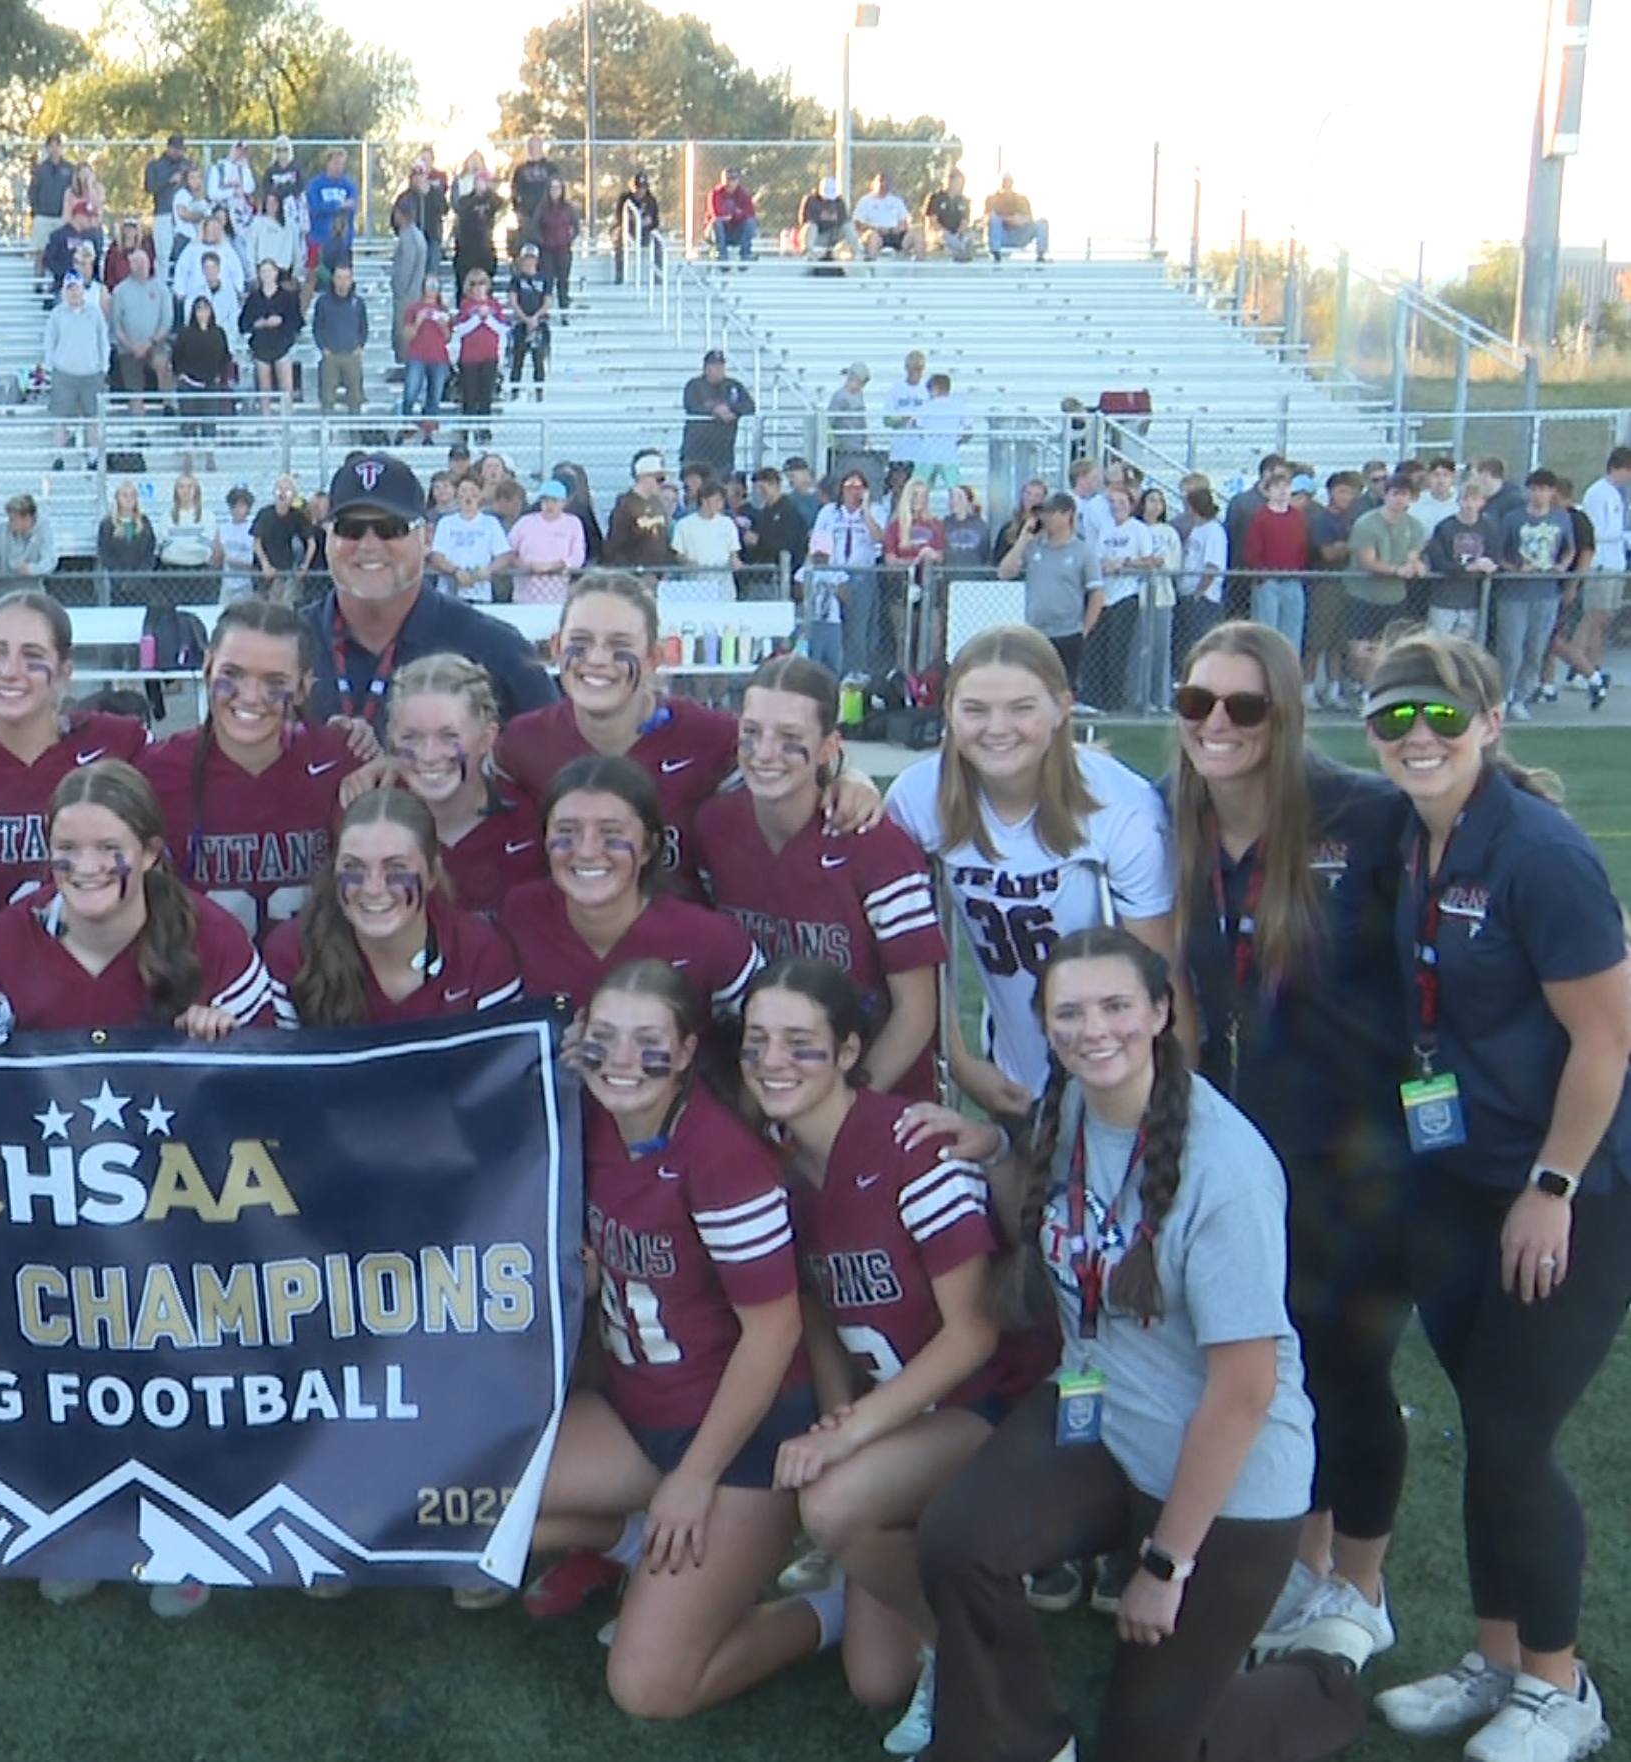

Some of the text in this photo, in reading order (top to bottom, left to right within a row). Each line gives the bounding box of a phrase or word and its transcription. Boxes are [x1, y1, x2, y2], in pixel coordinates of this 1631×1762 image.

[966, 898, 1060, 976] 36
[17, 1242, 535, 1349] CHAMPIONS
[47, 1364, 419, 1428] FOOTBALL
